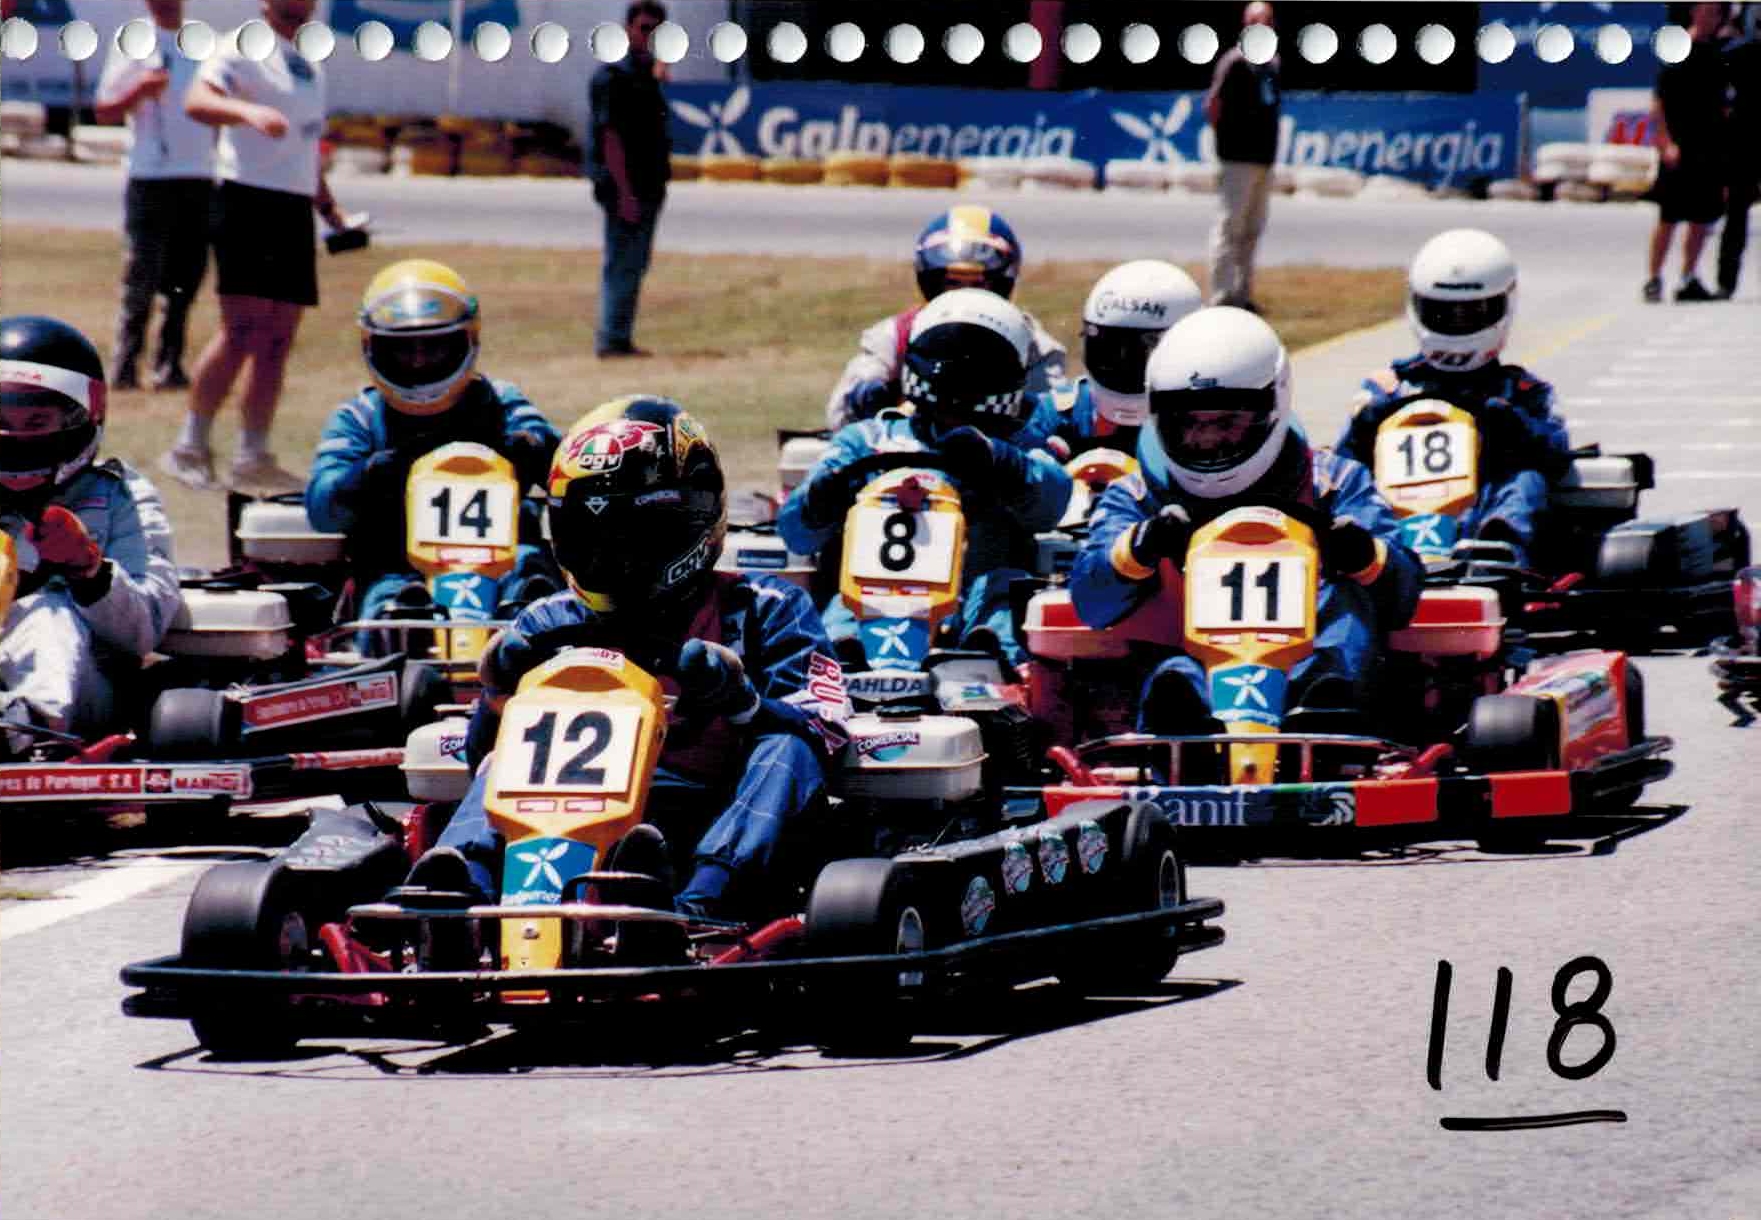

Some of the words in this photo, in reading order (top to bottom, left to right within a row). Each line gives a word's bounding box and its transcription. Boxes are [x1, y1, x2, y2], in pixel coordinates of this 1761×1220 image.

[1198, 113, 1503, 190] lpenergia
[1397, 429, 1453, 476] 18
[430, 486, 494, 539] 14
[878, 511, 917, 572] 8
[1220, 561, 1281, 622] 11
[522, 710, 613, 786] 12
[1427, 956, 1617, 1091] 118
